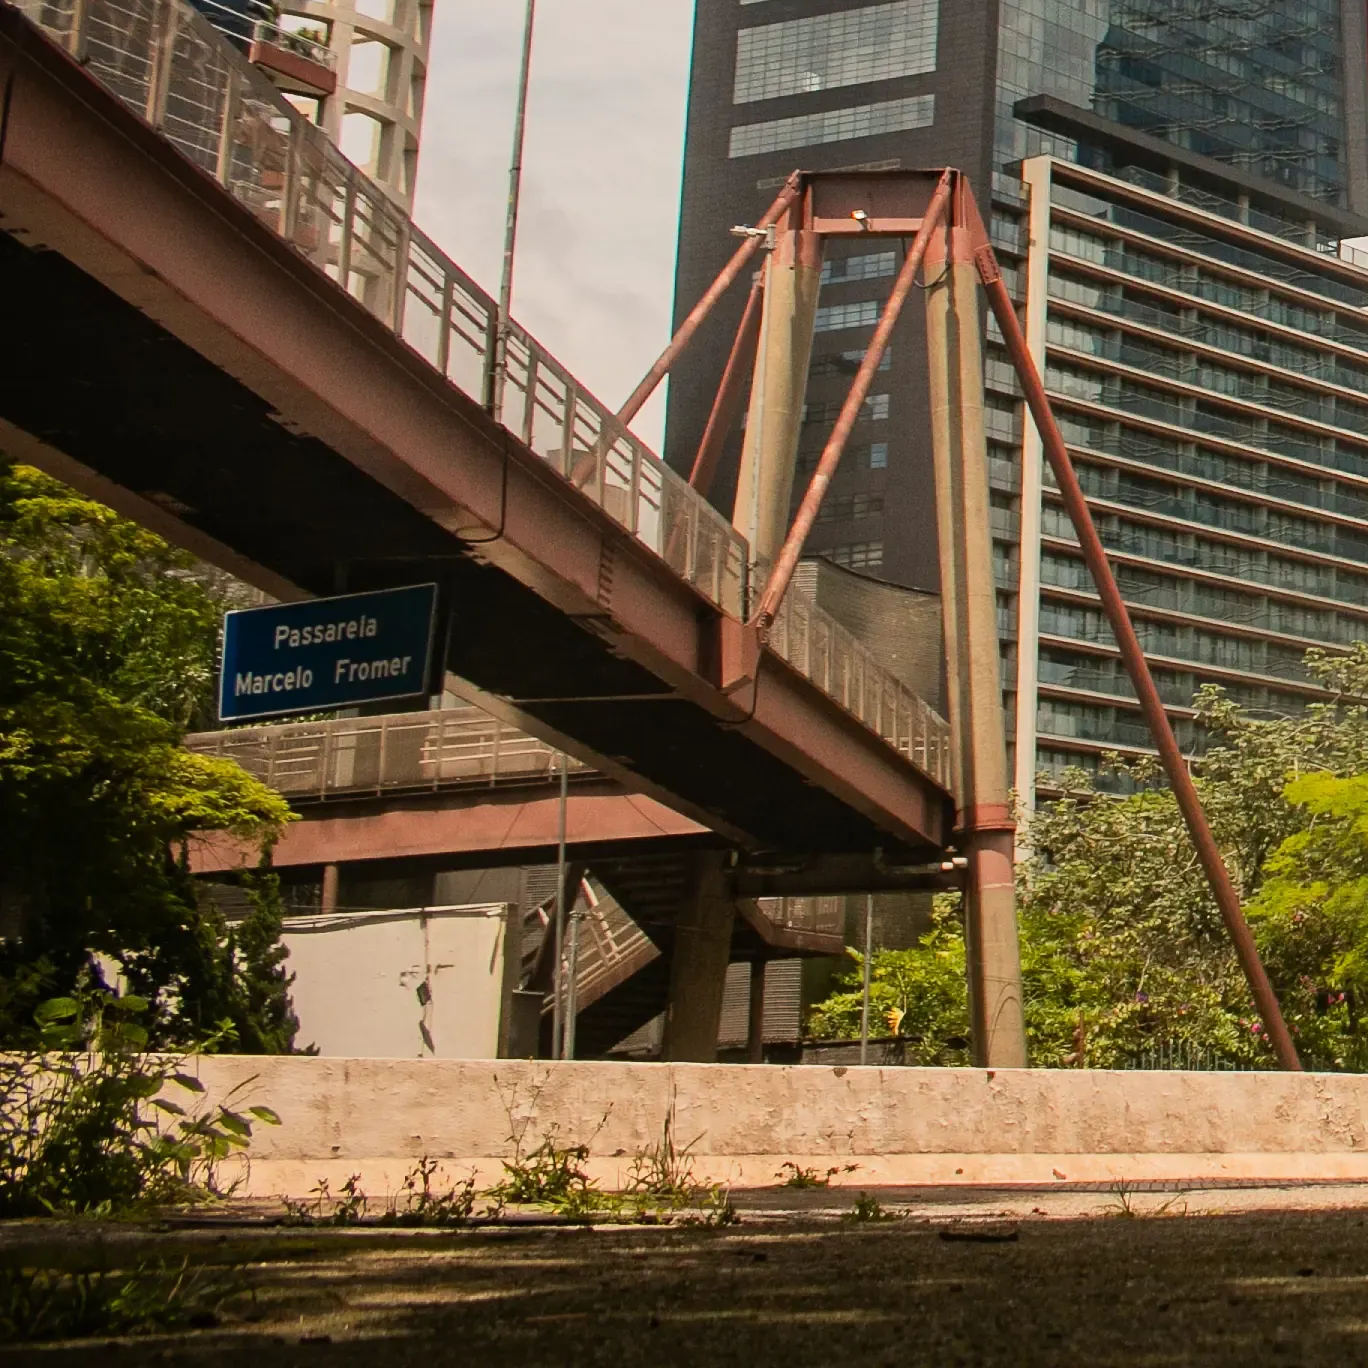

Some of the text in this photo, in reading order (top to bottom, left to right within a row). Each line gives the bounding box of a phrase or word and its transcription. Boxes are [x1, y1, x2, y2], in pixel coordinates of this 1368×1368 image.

[274, 615, 378, 650] Passarela
[234, 655, 412, 697] Marcelo Fromer
